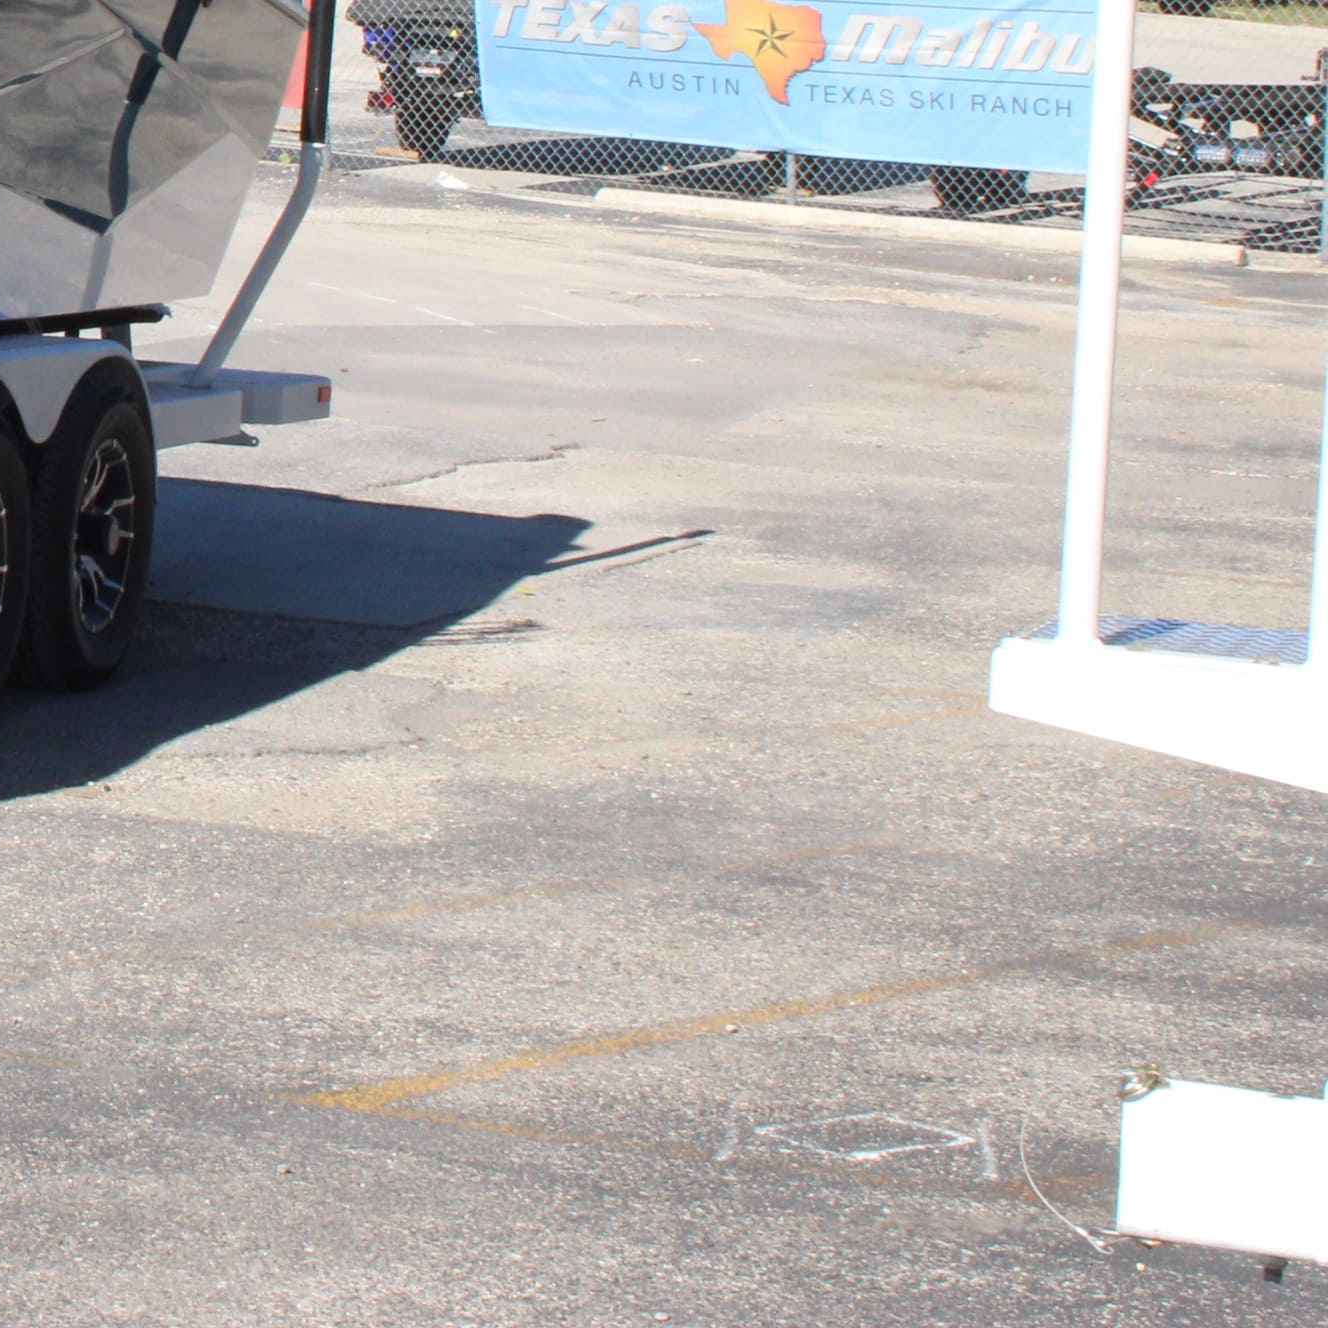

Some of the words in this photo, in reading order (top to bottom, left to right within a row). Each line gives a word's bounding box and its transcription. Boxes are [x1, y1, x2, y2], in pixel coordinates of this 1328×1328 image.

[830, 13, 1094, 75] Malibu
[627, 70, 740, 96] AUSTIN
[805, 83, 895, 108] TEXAS
[908, 89, 955, 111] SKI
[970, 93, 1073, 118] RANCH
